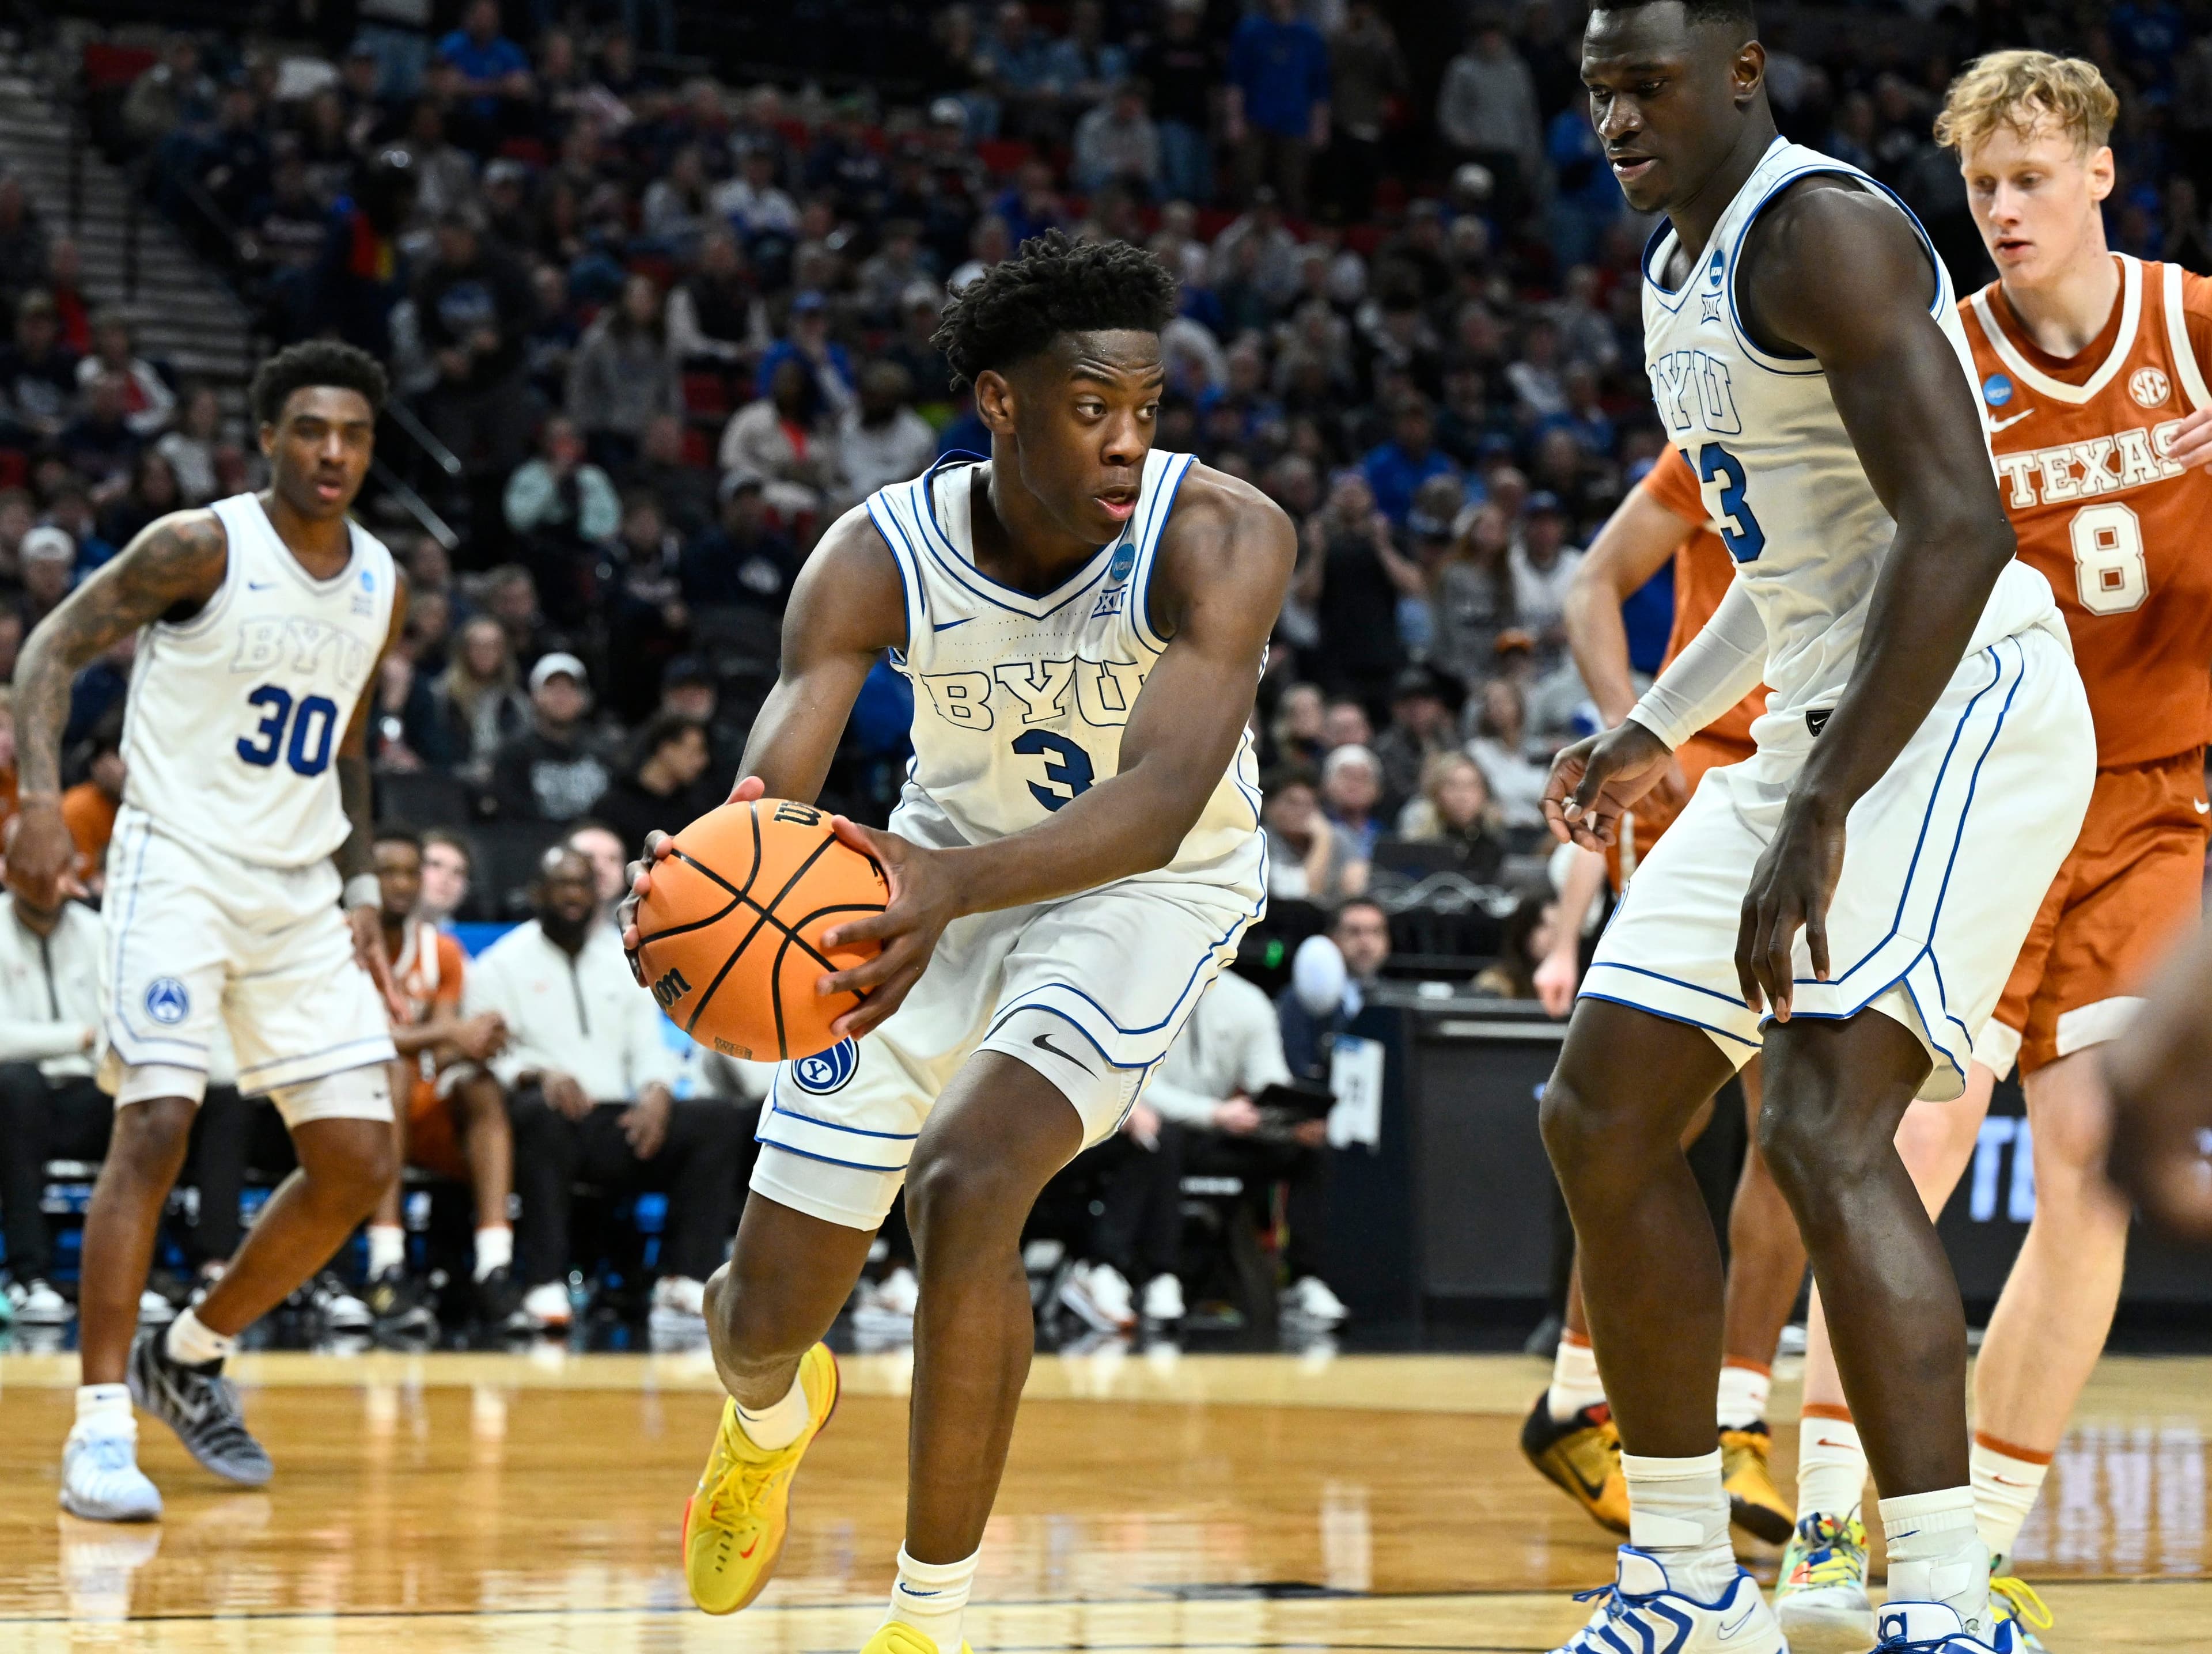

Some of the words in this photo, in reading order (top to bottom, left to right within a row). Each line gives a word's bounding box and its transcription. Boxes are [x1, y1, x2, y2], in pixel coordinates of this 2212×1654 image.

[2131, 370, 2168, 405] SEC
[1679, 441, 1766, 564] 3
[1993, 418, 2188, 509] TEXAS
[2069, 501, 2150, 616] 8
[230, 615, 372, 689] BYU
[919, 654, 1145, 731] BYU
[236, 684, 338, 777] 30
[1011, 729, 1094, 812] 3
